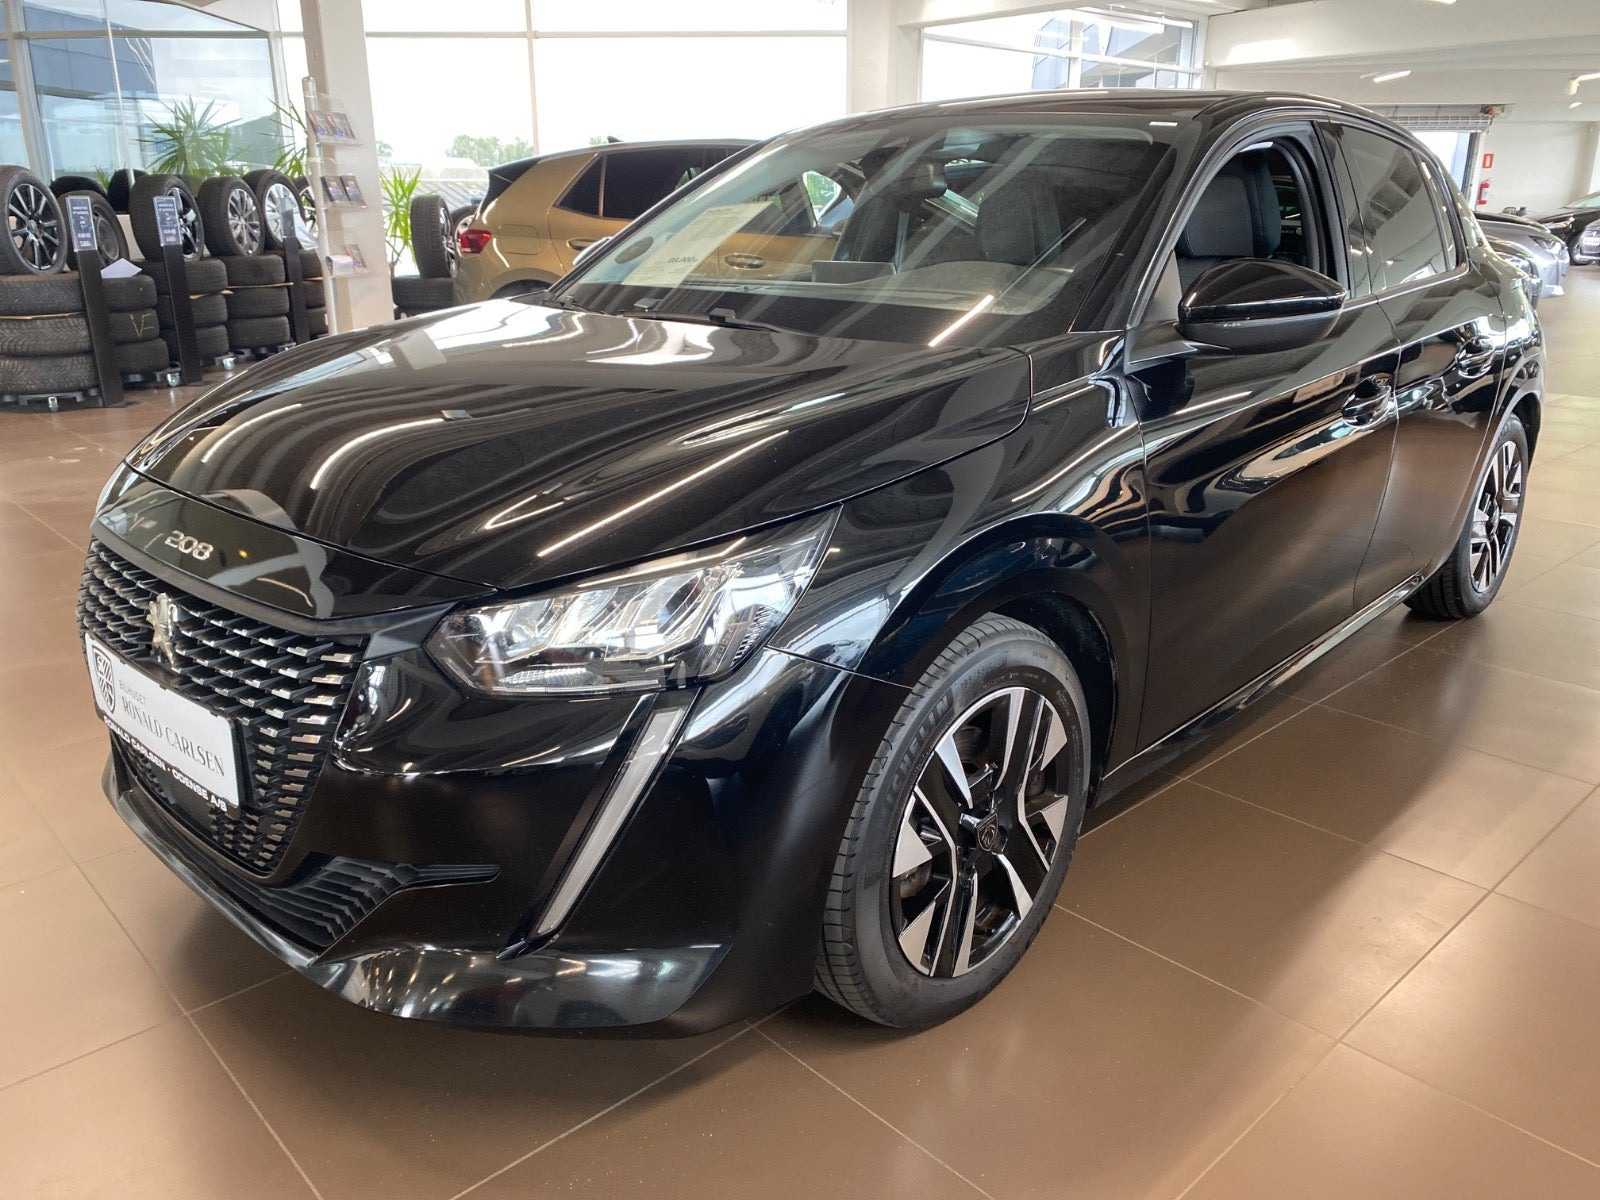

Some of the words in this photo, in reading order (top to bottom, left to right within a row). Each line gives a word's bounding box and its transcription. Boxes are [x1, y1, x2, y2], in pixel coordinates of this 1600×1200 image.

[164, 529, 214, 561] 208
[103, 715, 132, 744] RONALD
[130, 739, 166, 772] CARLSEN
[172, 769, 209, 800] ODENSE
[121, 695, 164, 739] RONALD
[165, 726, 225, 777] CARLSEN
[884, 693, 951, 811] ICHELIN
